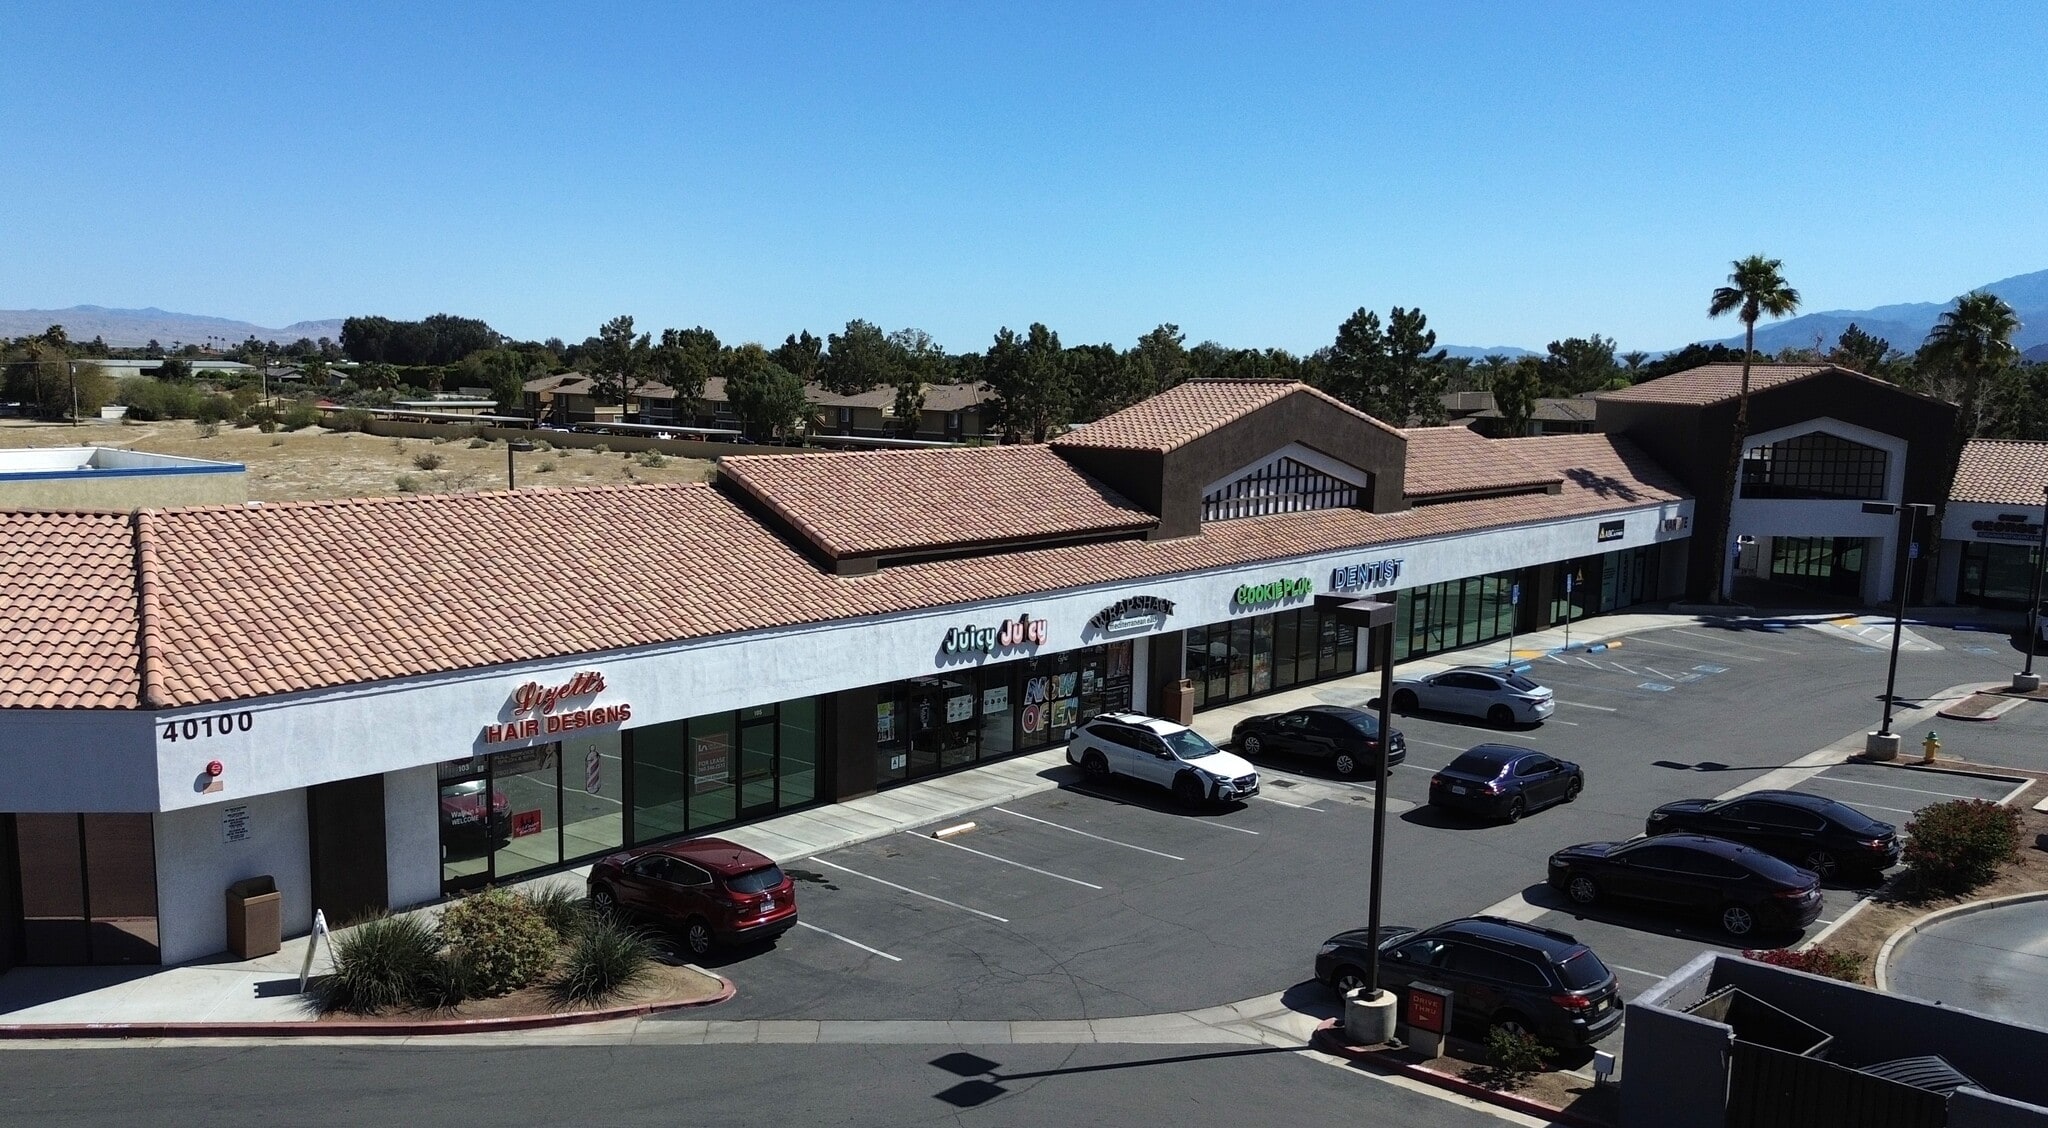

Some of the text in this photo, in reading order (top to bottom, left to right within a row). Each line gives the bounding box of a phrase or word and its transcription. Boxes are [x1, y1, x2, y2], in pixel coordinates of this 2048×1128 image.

[1333, 559, 1404, 588] DENTIST
[943, 613, 1047, 655] Juicy Juicy
[513, 671, 608, 717] Lizett's
[1024, 671, 1078, 705] NOW
[162, 711, 253, 742] 40100
[485, 703, 632, 744] HAIR DESIGNS
[1021, 697, 1079, 734] OPEN
[458, 764, 469, 772] 103
[452, 815, 480, 825] WELCOME
[1413, 995, 1438, 1007] DRIVE
[1414, 1003, 1437, 1015] THRU
